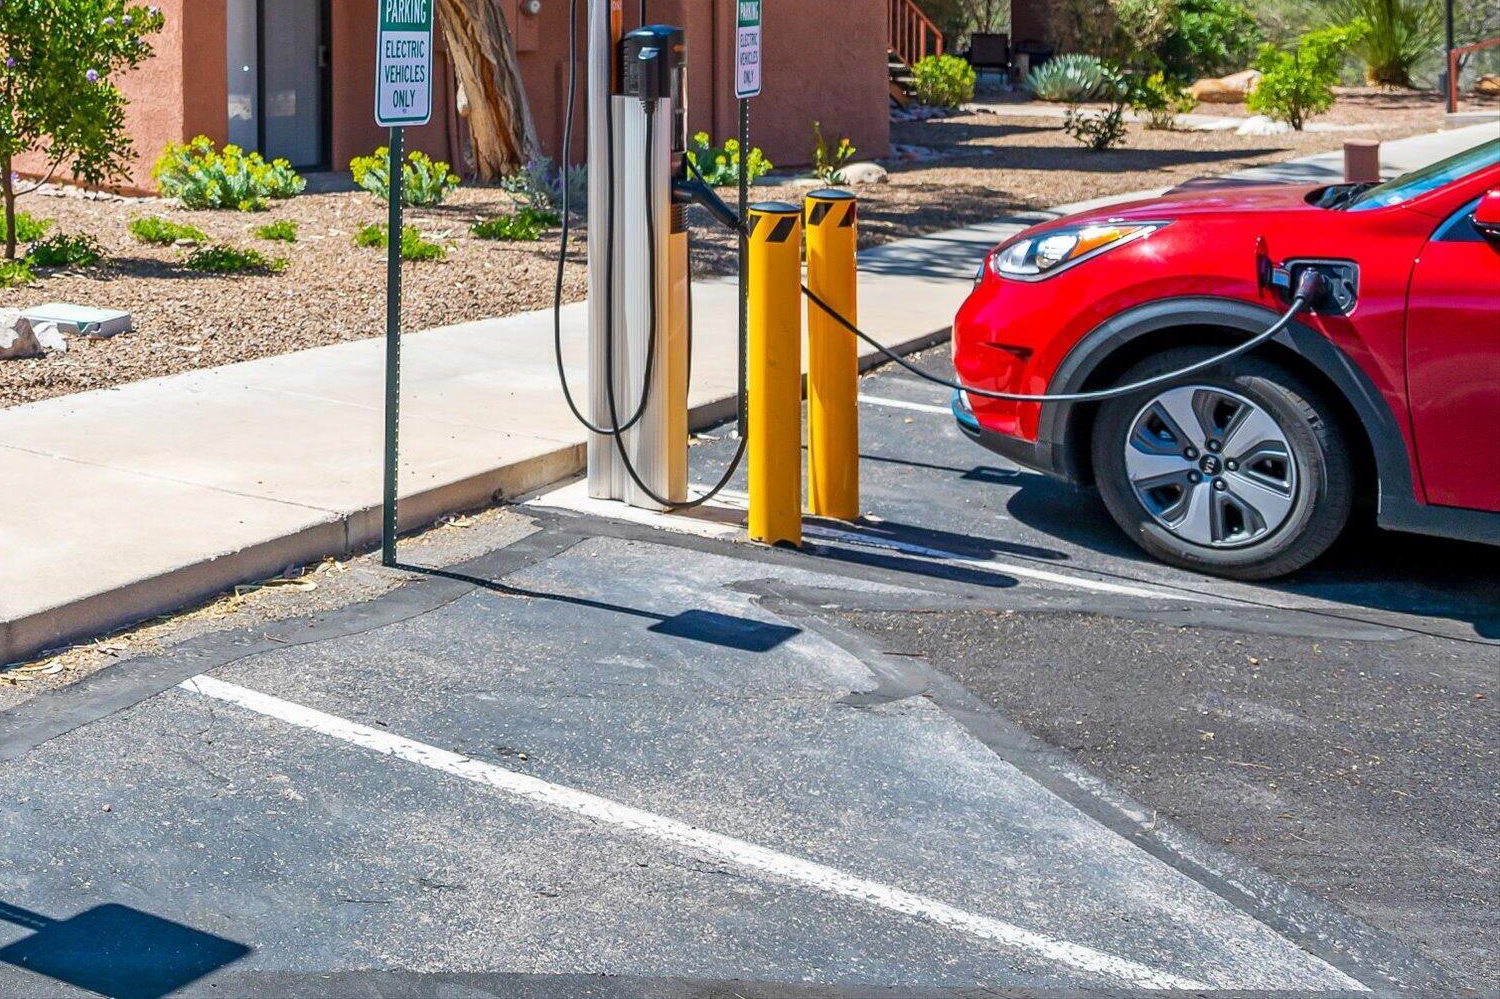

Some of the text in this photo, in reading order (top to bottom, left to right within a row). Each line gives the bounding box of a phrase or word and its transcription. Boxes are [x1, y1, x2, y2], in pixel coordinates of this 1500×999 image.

[740, 1, 759, 21] PARKING
[740, 33, 758, 47] ELECTRIC
[385, 40, 425, 59] ELECTRIC
[740, 51, 758, 65] VEHICLES
[385, 65, 425, 83] VEHICLES
[743, 70, 754, 84] ONLY
[392, 89, 416, 108] ONLY
